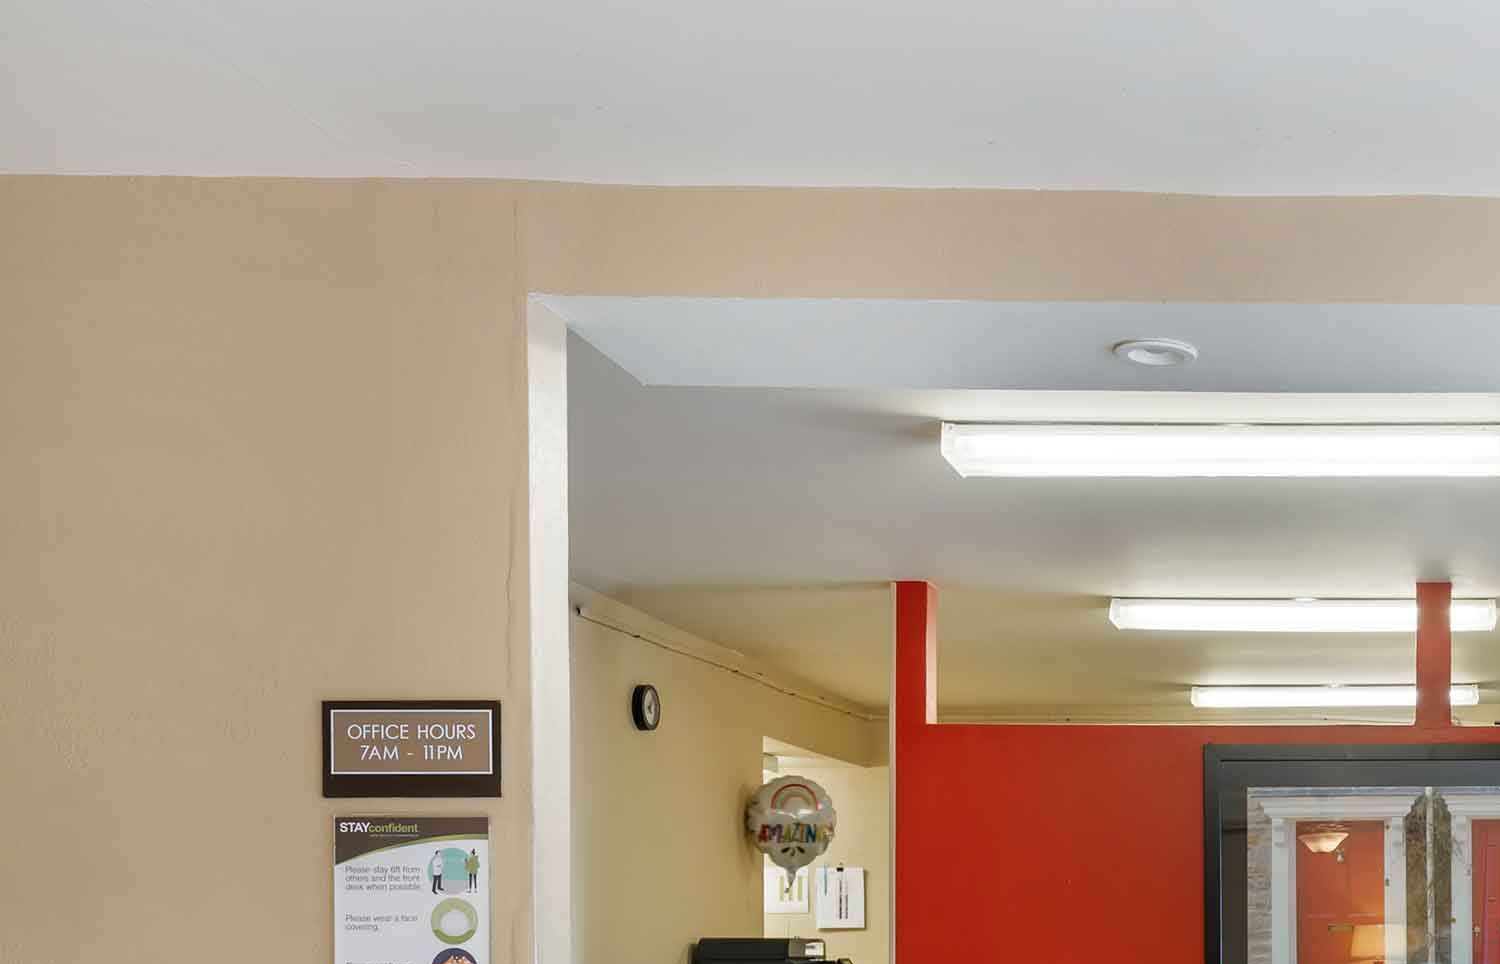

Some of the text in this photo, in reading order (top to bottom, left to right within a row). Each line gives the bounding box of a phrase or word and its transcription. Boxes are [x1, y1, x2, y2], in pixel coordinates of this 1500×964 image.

[347, 723, 476, 740] OFFICE HOURS
[360, 745, 400, 760] 7AM
[423, 745, 463, 760] 11PM
